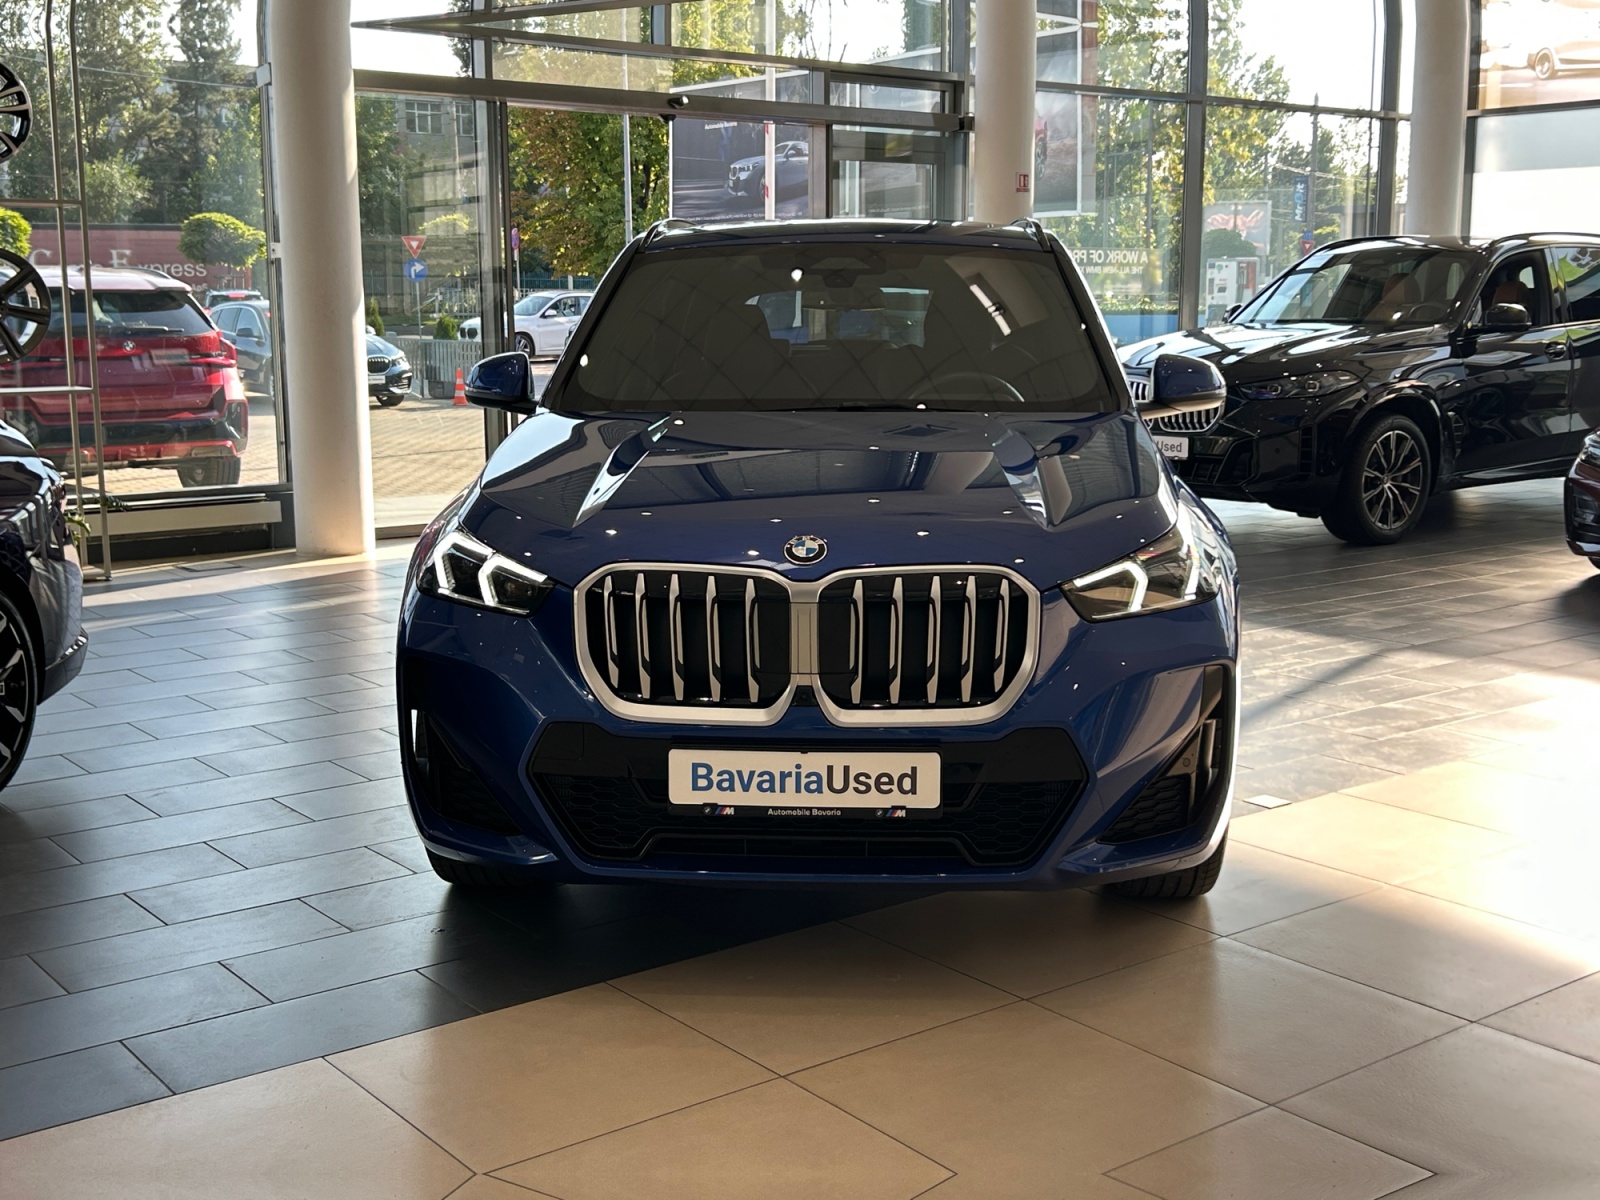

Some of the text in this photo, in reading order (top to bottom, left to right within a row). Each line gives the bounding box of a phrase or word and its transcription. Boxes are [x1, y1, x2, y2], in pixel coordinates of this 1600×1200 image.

[691, 762, 918, 796] BavariaUsed
[767, 808, 842, 816] Automobile Bavaria
